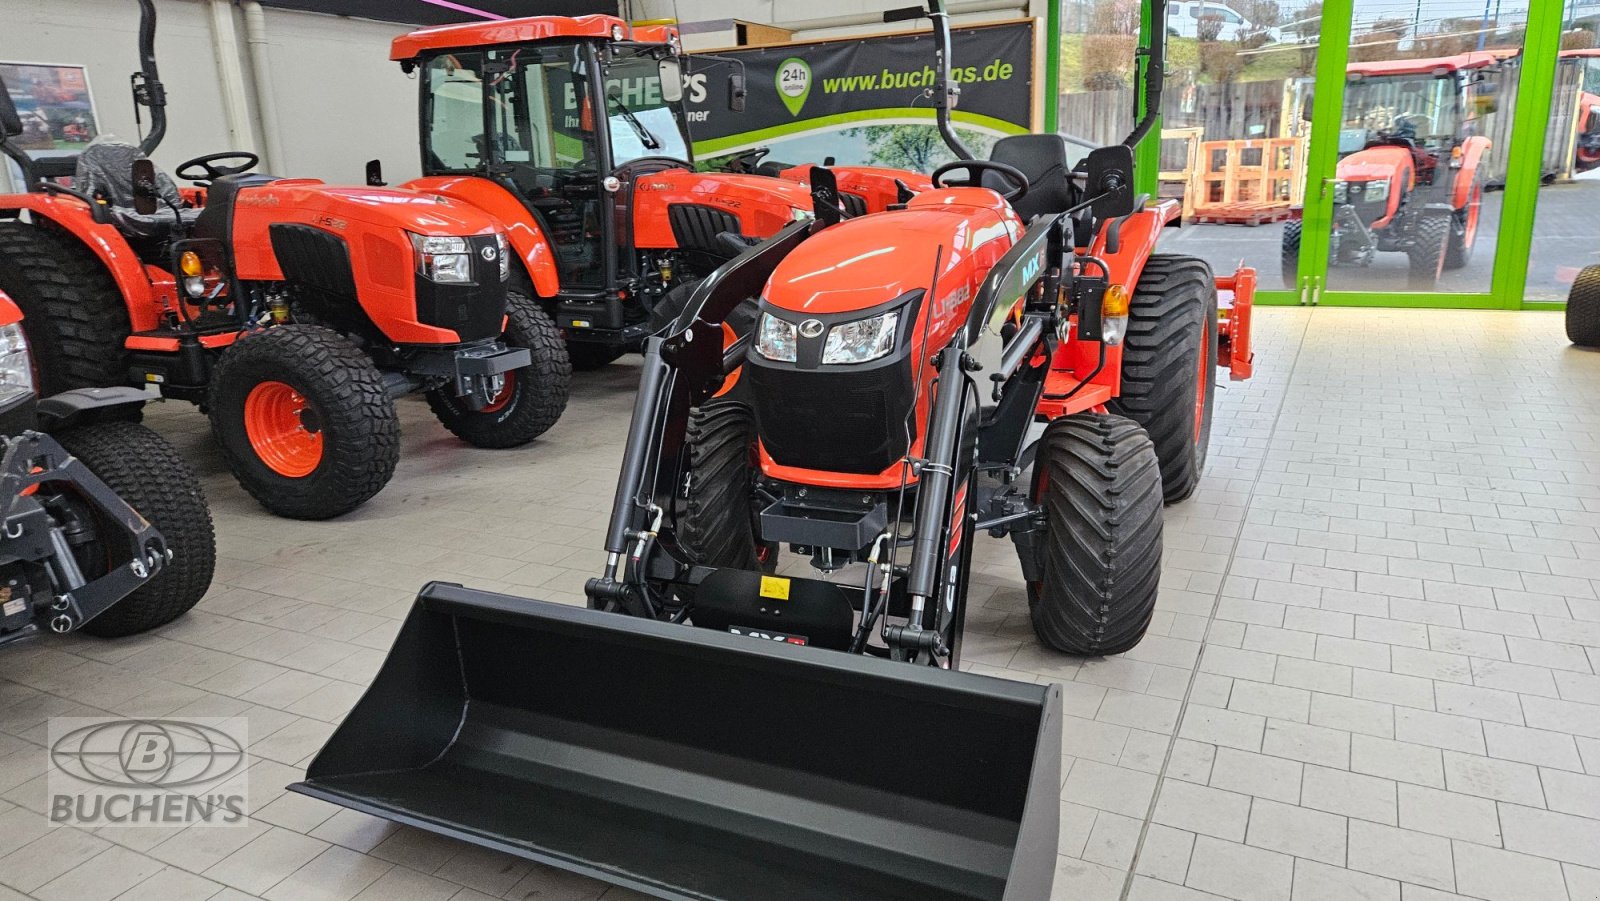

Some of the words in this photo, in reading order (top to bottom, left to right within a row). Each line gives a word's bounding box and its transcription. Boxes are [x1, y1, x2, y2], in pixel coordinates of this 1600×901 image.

[564, 73, 707, 110] BCHE'S
[783, 68, 806, 82] 24h
[823, 59, 1013, 94] www.buchns.de
